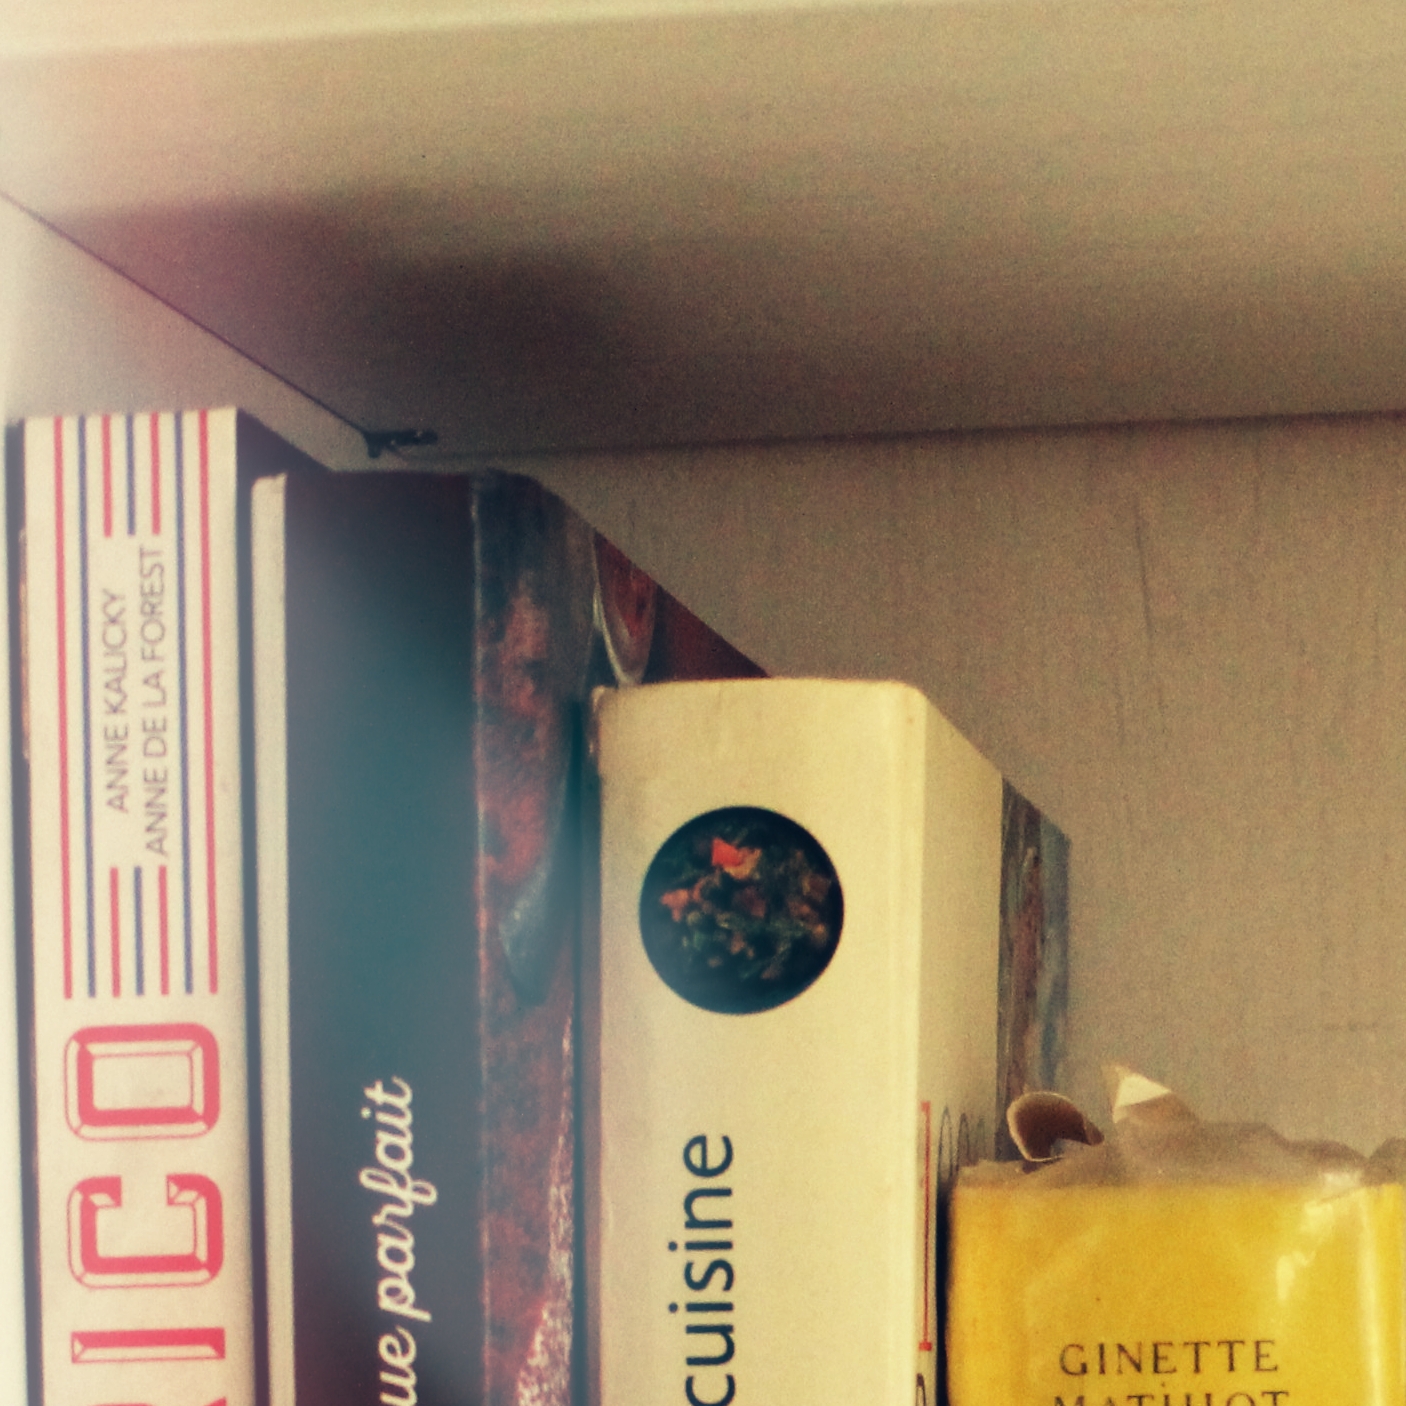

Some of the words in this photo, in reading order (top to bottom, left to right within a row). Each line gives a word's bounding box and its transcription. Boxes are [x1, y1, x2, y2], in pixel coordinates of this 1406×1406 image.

[139, 544, 165, 662] FOREST
[102, 588, 128, 714] KALICKY
[142, 669, 166, 707] LA
[104, 724, 128, 814] ANNE
[142, 716, 167, 757] DE
[143, 768, 168, 857] ANNE
[359, 1075, 438, 1322] parfait
[1059, 1340, 1278, 1375] GINETTE
